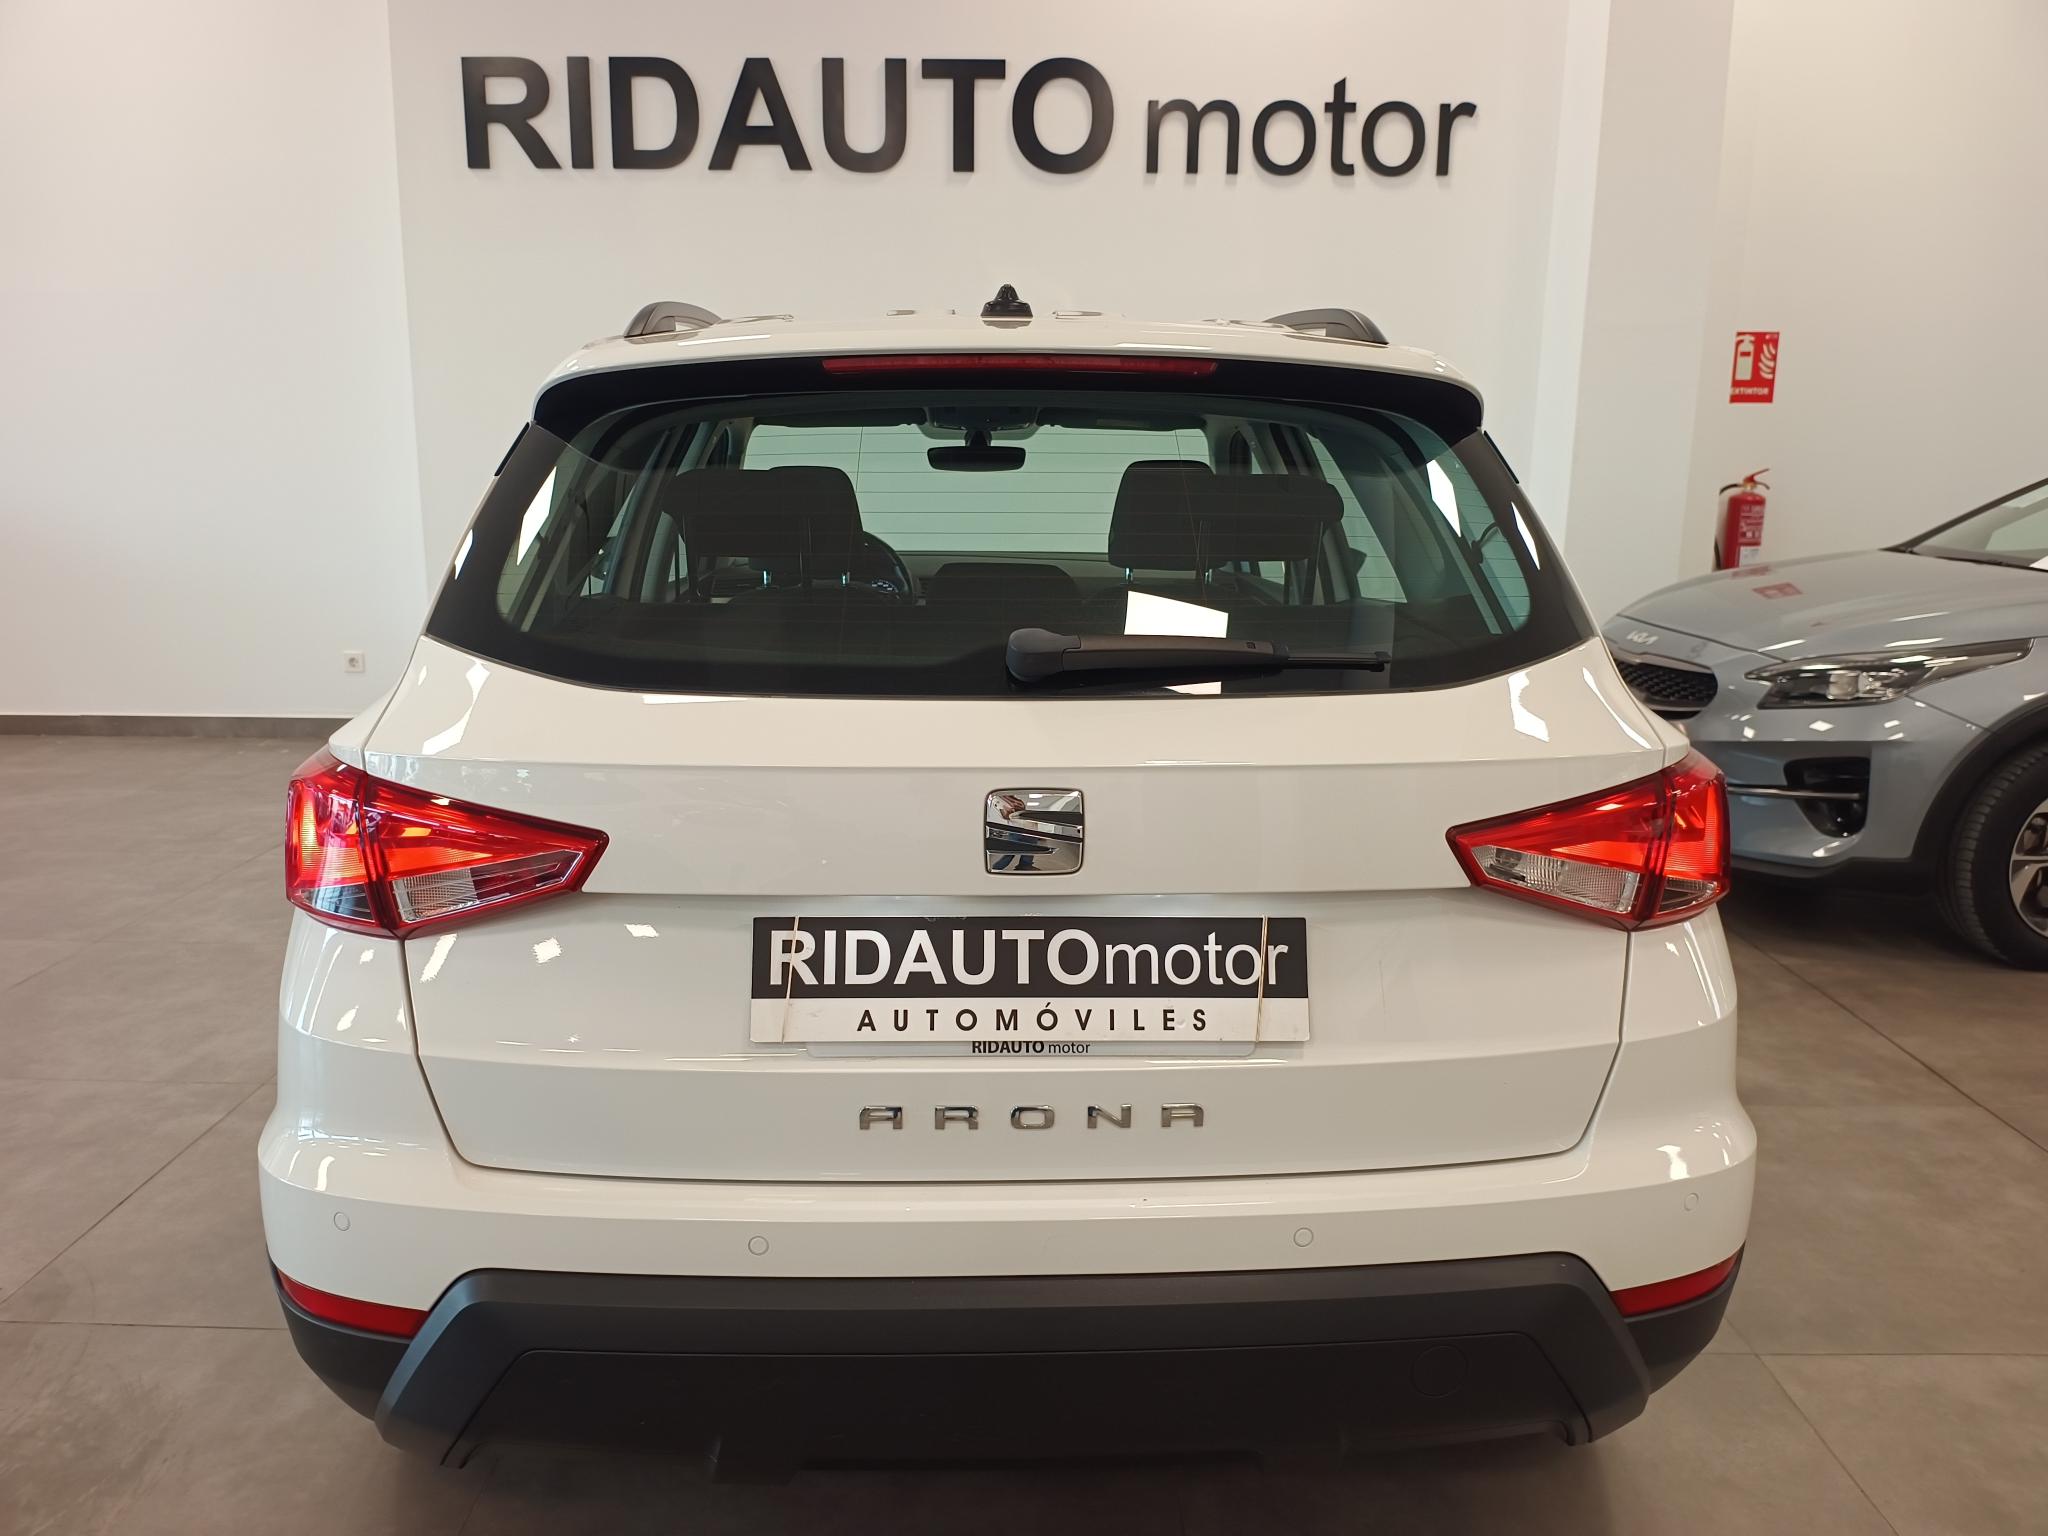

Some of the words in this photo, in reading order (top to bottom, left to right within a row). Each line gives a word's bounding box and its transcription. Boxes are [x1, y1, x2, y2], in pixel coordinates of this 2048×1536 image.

[460, 56, 1114, 175] RIDAUTO
[1146, 77, 1477, 178] motor
[857, 1002, 1207, 1032] AUTOMÓVILES
[971, 1040, 1045, 1054] RIDAUTO
[1048, 1042, 1091, 1054] motor
[858, 1103, 1205, 1131] ARONA
